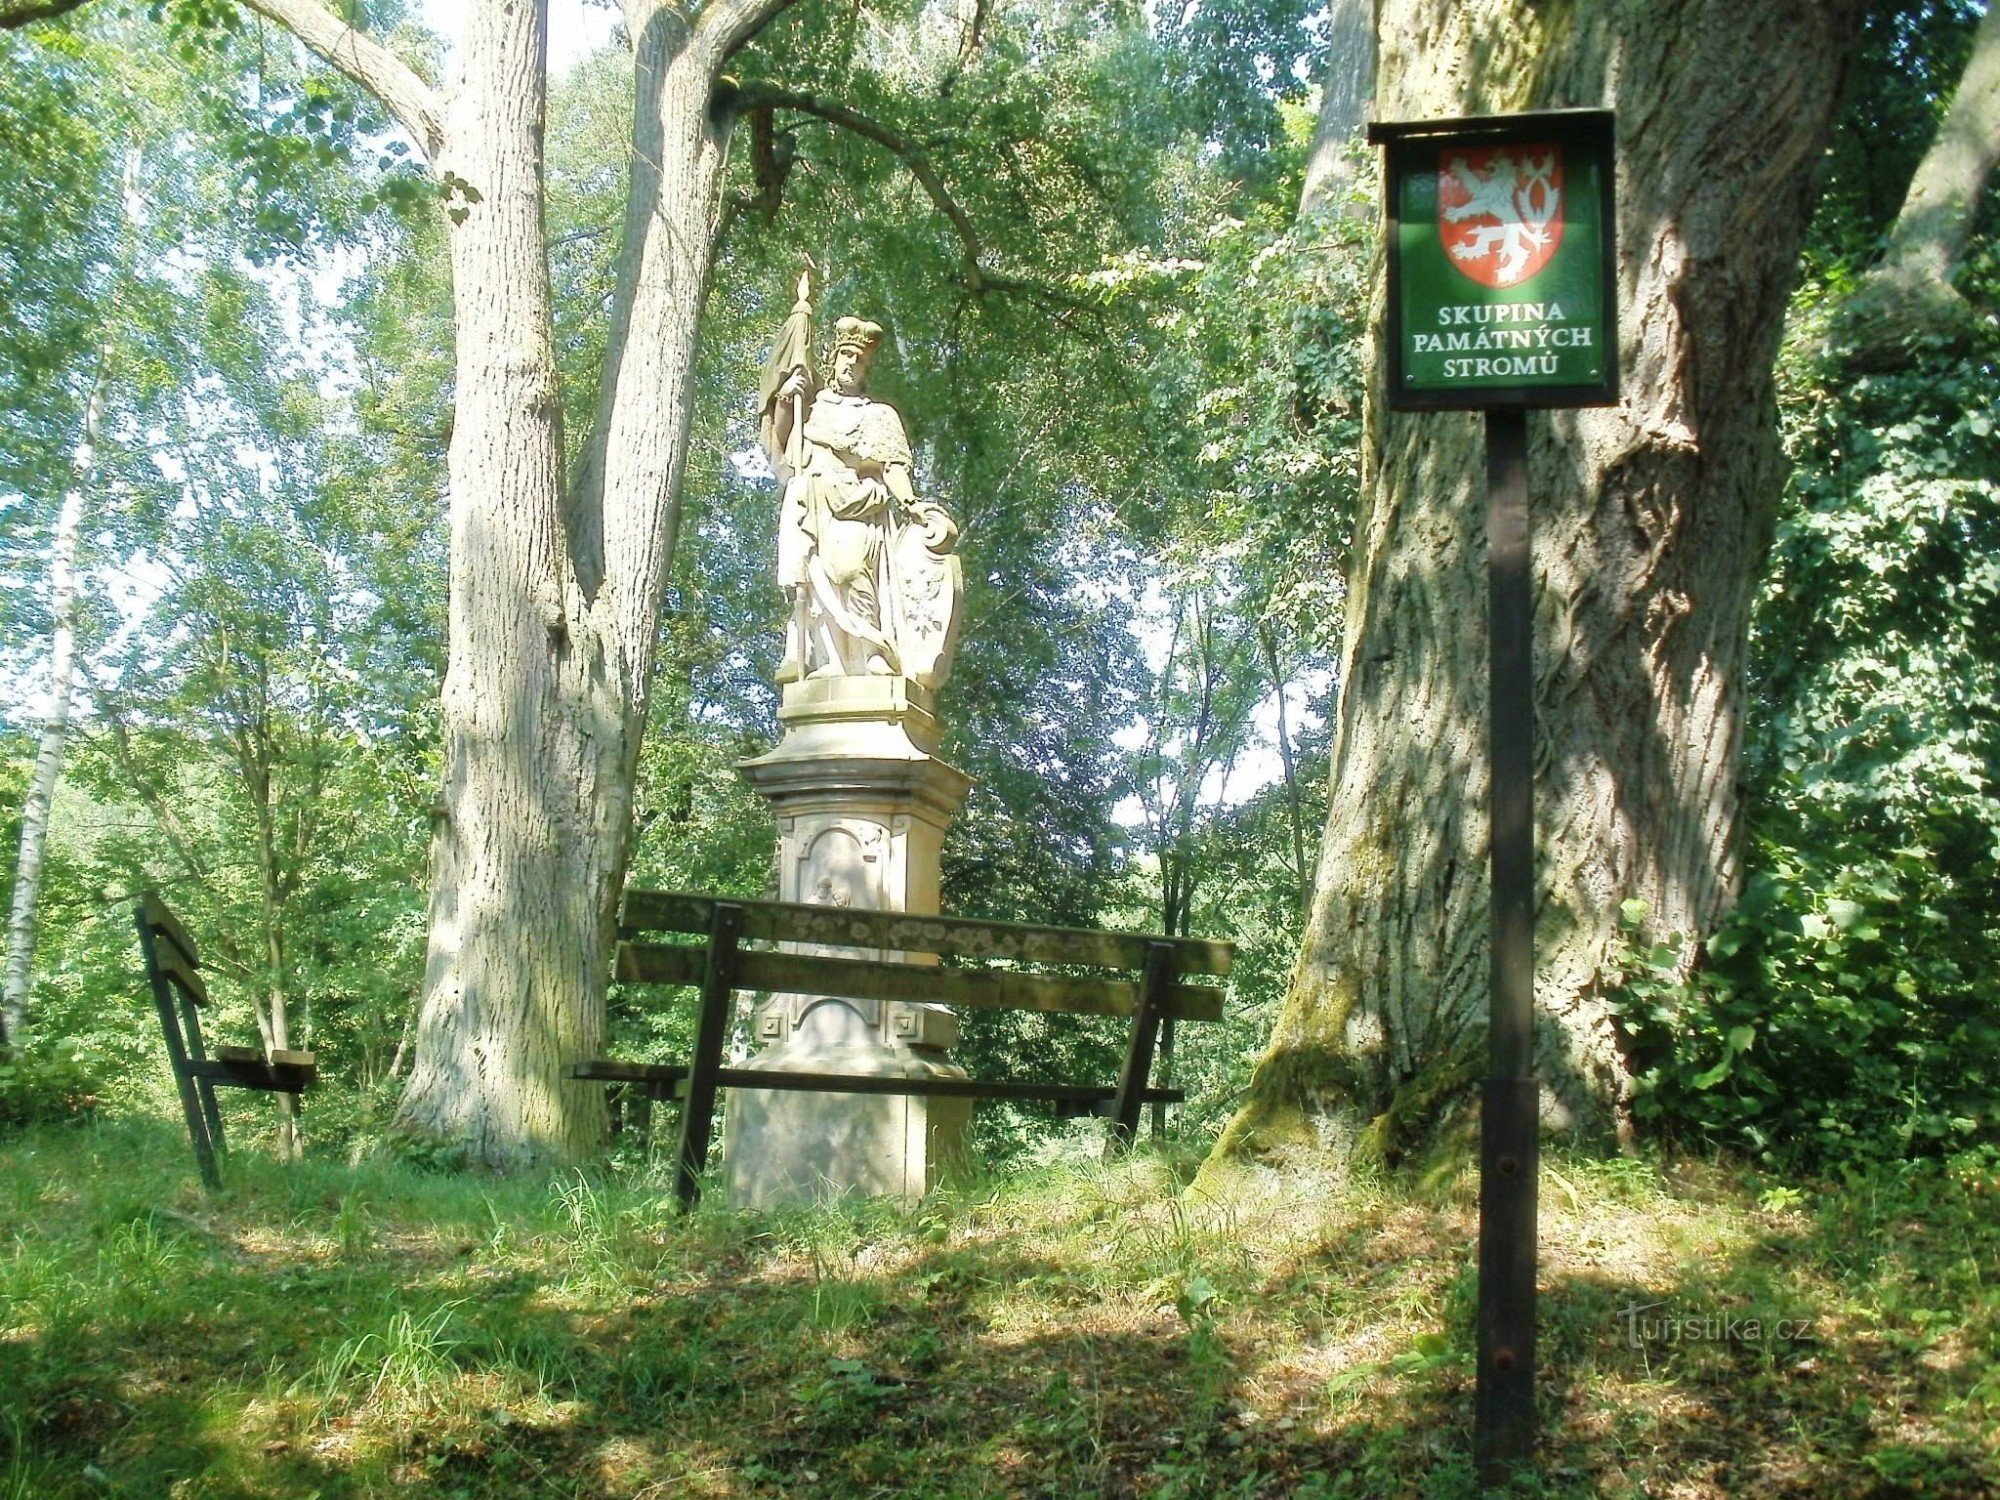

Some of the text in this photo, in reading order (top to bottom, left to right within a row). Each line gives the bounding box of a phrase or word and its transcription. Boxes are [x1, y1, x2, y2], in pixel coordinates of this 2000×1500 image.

[1438, 302, 1565, 325] SKUPINA
[1413, 325, 1593, 352] PAMÁTNÝCH
[1443, 350, 1560, 378] STROMŮ
